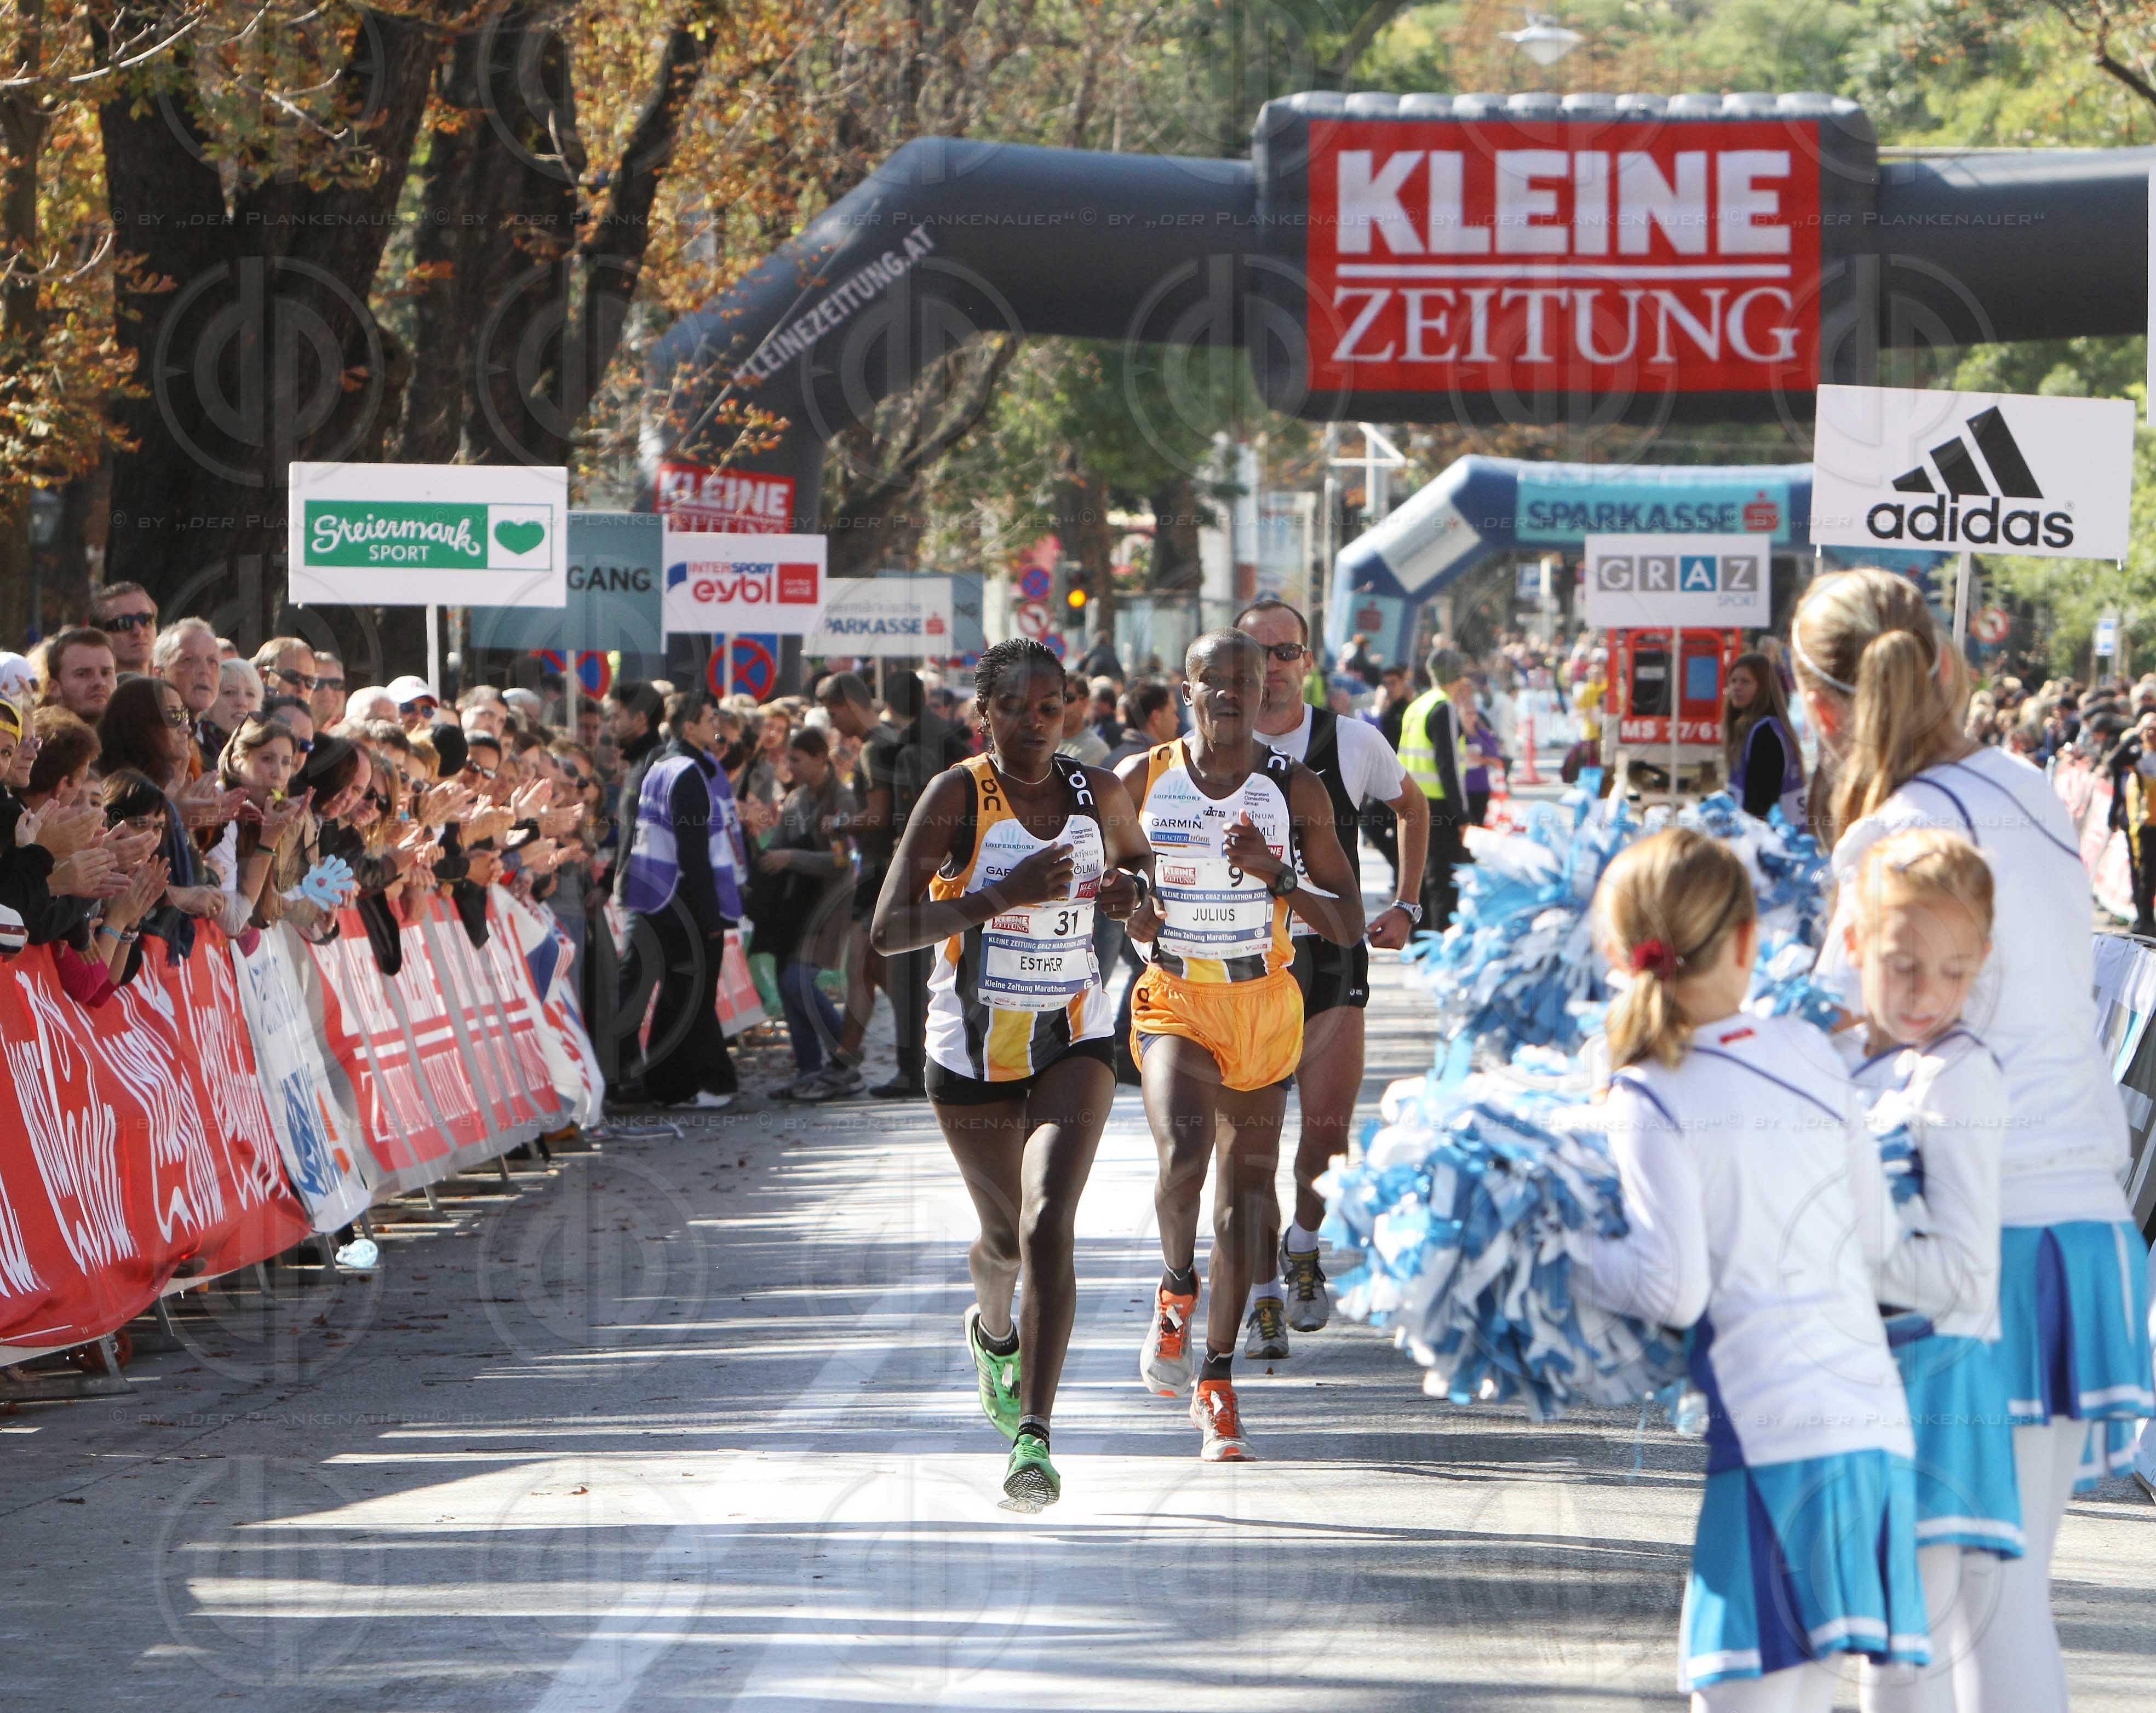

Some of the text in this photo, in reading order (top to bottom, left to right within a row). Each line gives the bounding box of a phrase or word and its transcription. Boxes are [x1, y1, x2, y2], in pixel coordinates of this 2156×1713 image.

[1337, 149, 1791, 256] KLEINE
[1331, 286, 1801, 364] ZEITUNG
[659, 470, 789, 517] KLEINE
[1528, 501, 1736, 533] SPARKASSE
[1867, 493, 2074, 548] adidas
[311, 513, 480, 556] Steiermark
[369, 544, 430, 561] SPORT
[689, 562, 774, 574] INTERSPORT
[1601, 557, 1754, 590] GRAZ
[693, 574, 771, 603] eybl
[1717, 594, 1758, 607] SPORT
[824, 617, 922, 634] PARKASSE
[1621, 720, 1657, 739] MS
[1165, 867, 1195, 876] KLEINE
[1165, 876, 1195, 884] ZEITUNG
[1228, 865, 1243, 887] 9
[994, 915, 1028, 926] KLEINE
[1054, 910, 1079, 936] 31
[1192, 908, 1235, 921] JULIUS
[993, 923, 1028, 932] ZEITUNG
[1163, 928, 1236, 941] Kleine Zeitung Marathon
[989, 936, 1009, 945] KLEINE
[1010, 940, 1036, 950] ZEITUNG
[1020, 956, 1062, 972] ESTHER
[985, 979, 1005, 989] Kleine
[1007, 982, 1033, 992] Zeitung
